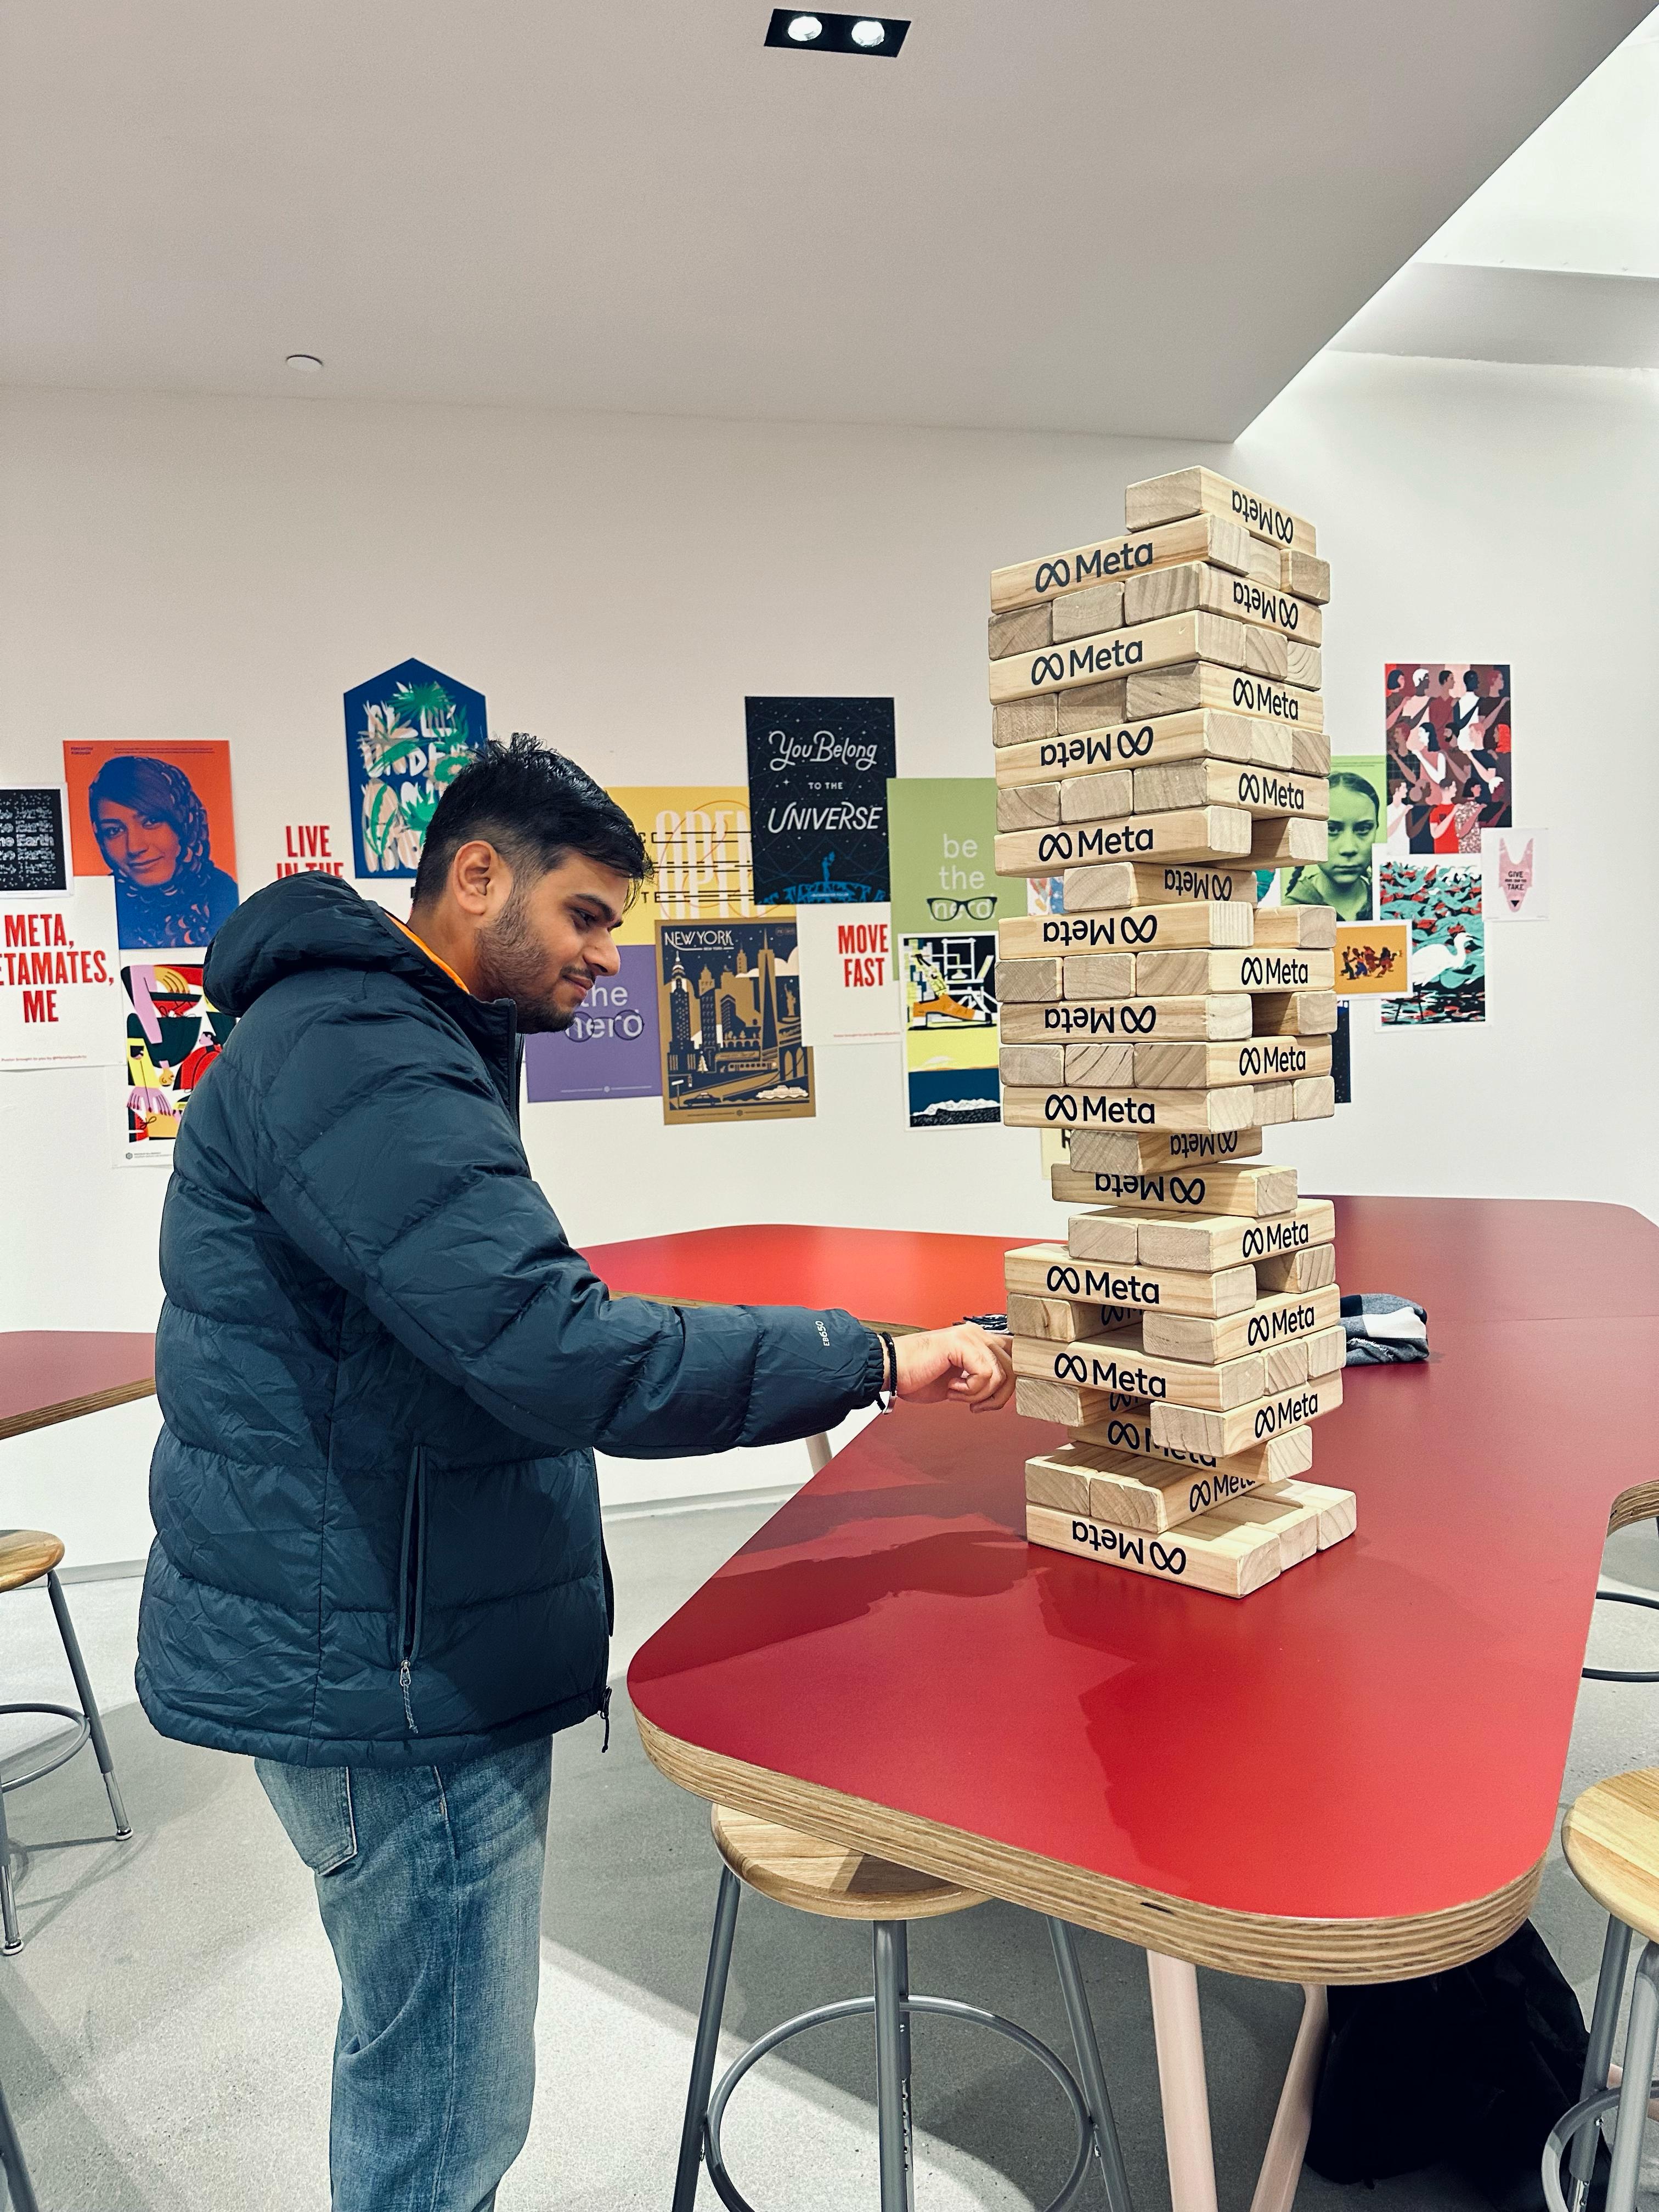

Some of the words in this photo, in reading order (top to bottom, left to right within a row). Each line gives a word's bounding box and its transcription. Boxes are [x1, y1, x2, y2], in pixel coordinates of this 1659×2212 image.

[1232, 490, 1273, 531] Meta
[1076, 543, 1152, 582] Meta
[1233, 582, 1276, 622] Meta
[1070, 640, 1143, 678] Meta
[1258, 684, 1299, 720] Meta
[768, 730, 813, 771] You
[810, 730, 878, 771] Belong
[1041, 732, 1110, 768] Meta
[808, 782, 822, 790] TO
[825, 782, 844, 790] THE
[1263, 778, 1304, 810] Meta
[768, 801, 883, 834] UNIVERSE
[285, 826, 332, 857] LIVE
[943, 833, 978, 859] be
[1079, 826, 1153, 857] Meta
[939, 865, 985, 890] the
[1165, 870, 1209, 900] Meta
[4, 914, 75, 949] META,
[664, 931, 696, 946] NEW
[696, 930, 734, 946] YORK
[838, 924, 889, 955] MOVE
[1044, 918, 1114, 946] Meta
[844, 957, 885, 988] FAST
[1267, 958, 1307, 984] Meta
[22, 990, 59, 1023] ME
[1045, 1007, 1114, 1033] Meta
[1265, 1047, 1305, 1073] Meta
[1084, 1096, 1155, 1124] Meta
[1171, 1133, 1215, 1158] Meta
[1095, 1173, 1164, 1201] Meta
[1267, 1221, 1309, 1251] Meta
[1086, 1270, 1159, 1304] Meta
[1273, 1305, 1314, 1338] Meta
[1092, 1359, 1166, 1398] Meta
[1279, 1393, 1318, 1429] Meta
[1073, 1521, 1144, 1564] Meta
